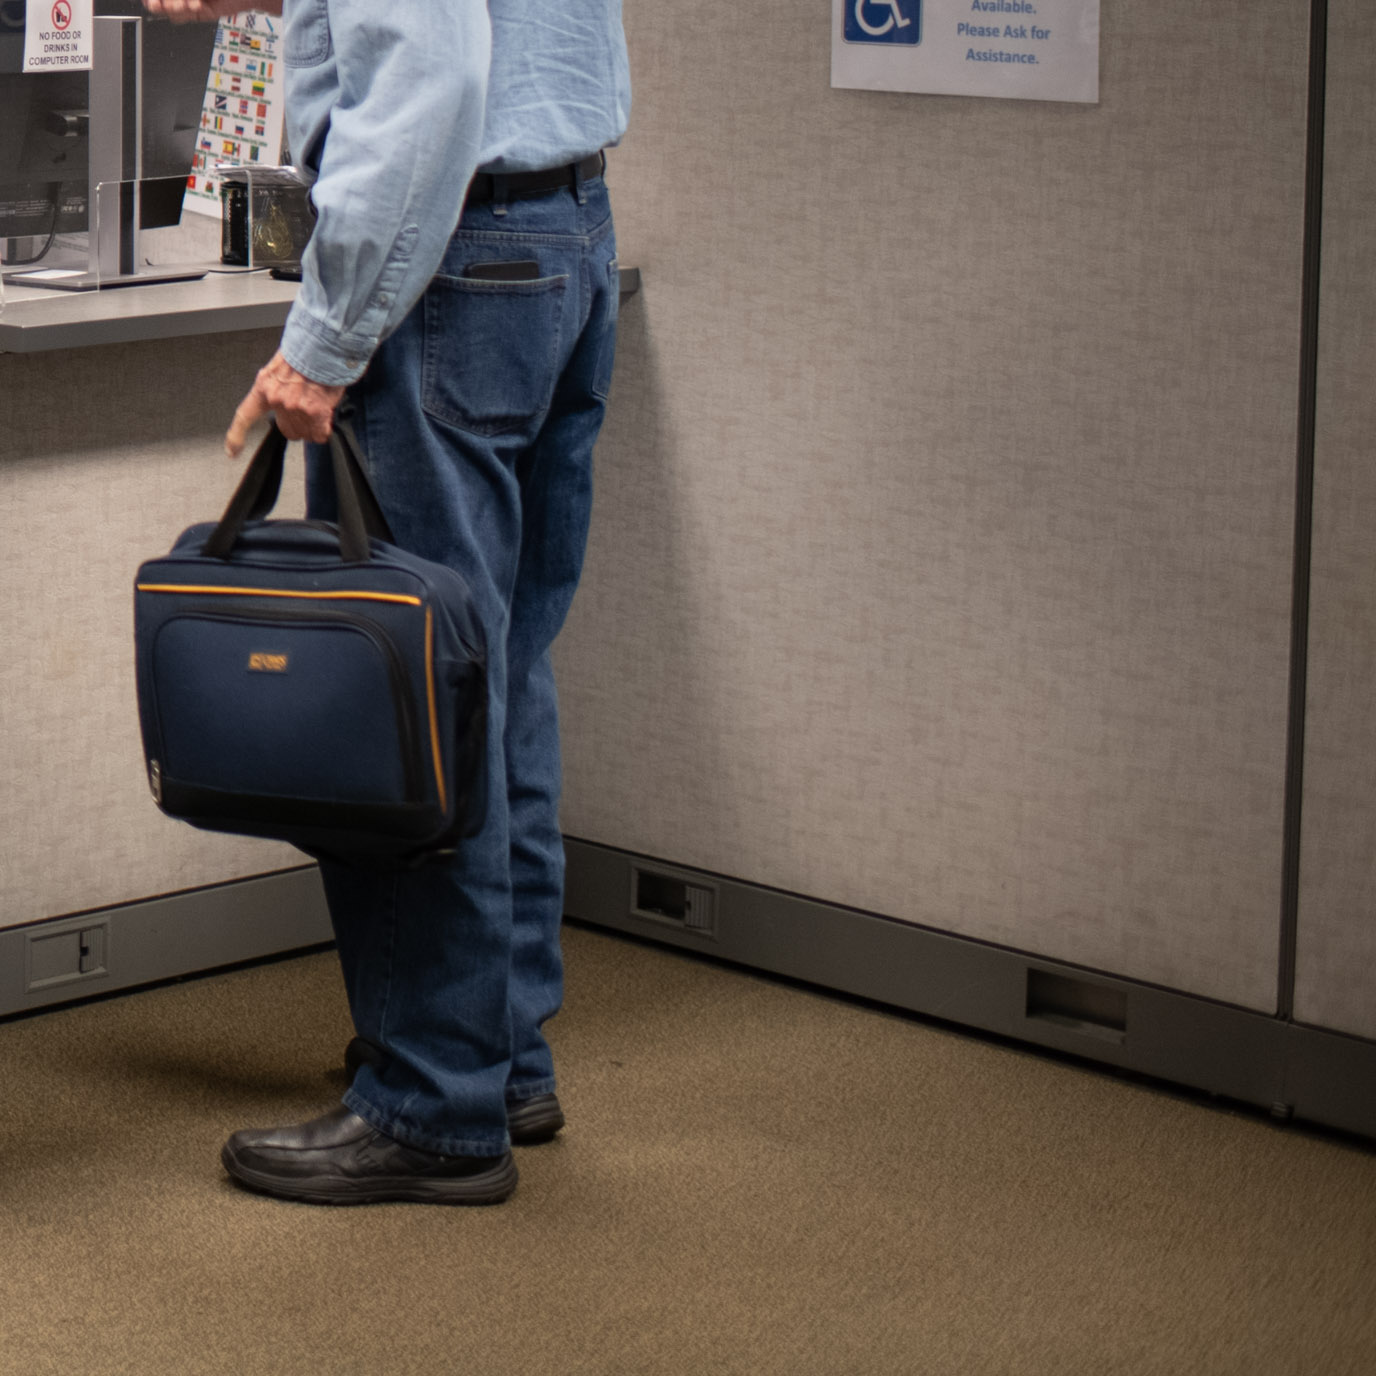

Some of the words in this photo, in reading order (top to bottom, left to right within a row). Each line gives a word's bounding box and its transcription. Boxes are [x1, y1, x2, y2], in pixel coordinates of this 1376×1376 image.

[39, 32, 50, 40] NO
[51, 30, 71, 40] FOOD
[72, 30, 82, 39] OR
[957, 22, 1000, 37] Please
[1003, 25, 1027, 39] Ask
[1031, 25, 1051, 40] for
[44, 43, 70, 53] DRINKS
[71, 43, 78, 52] IN
[29, 56, 69, 66] COMPUTER
[70, 54, 89, 64] ROOM
[966, 48, 1040, 65] Assistance.
